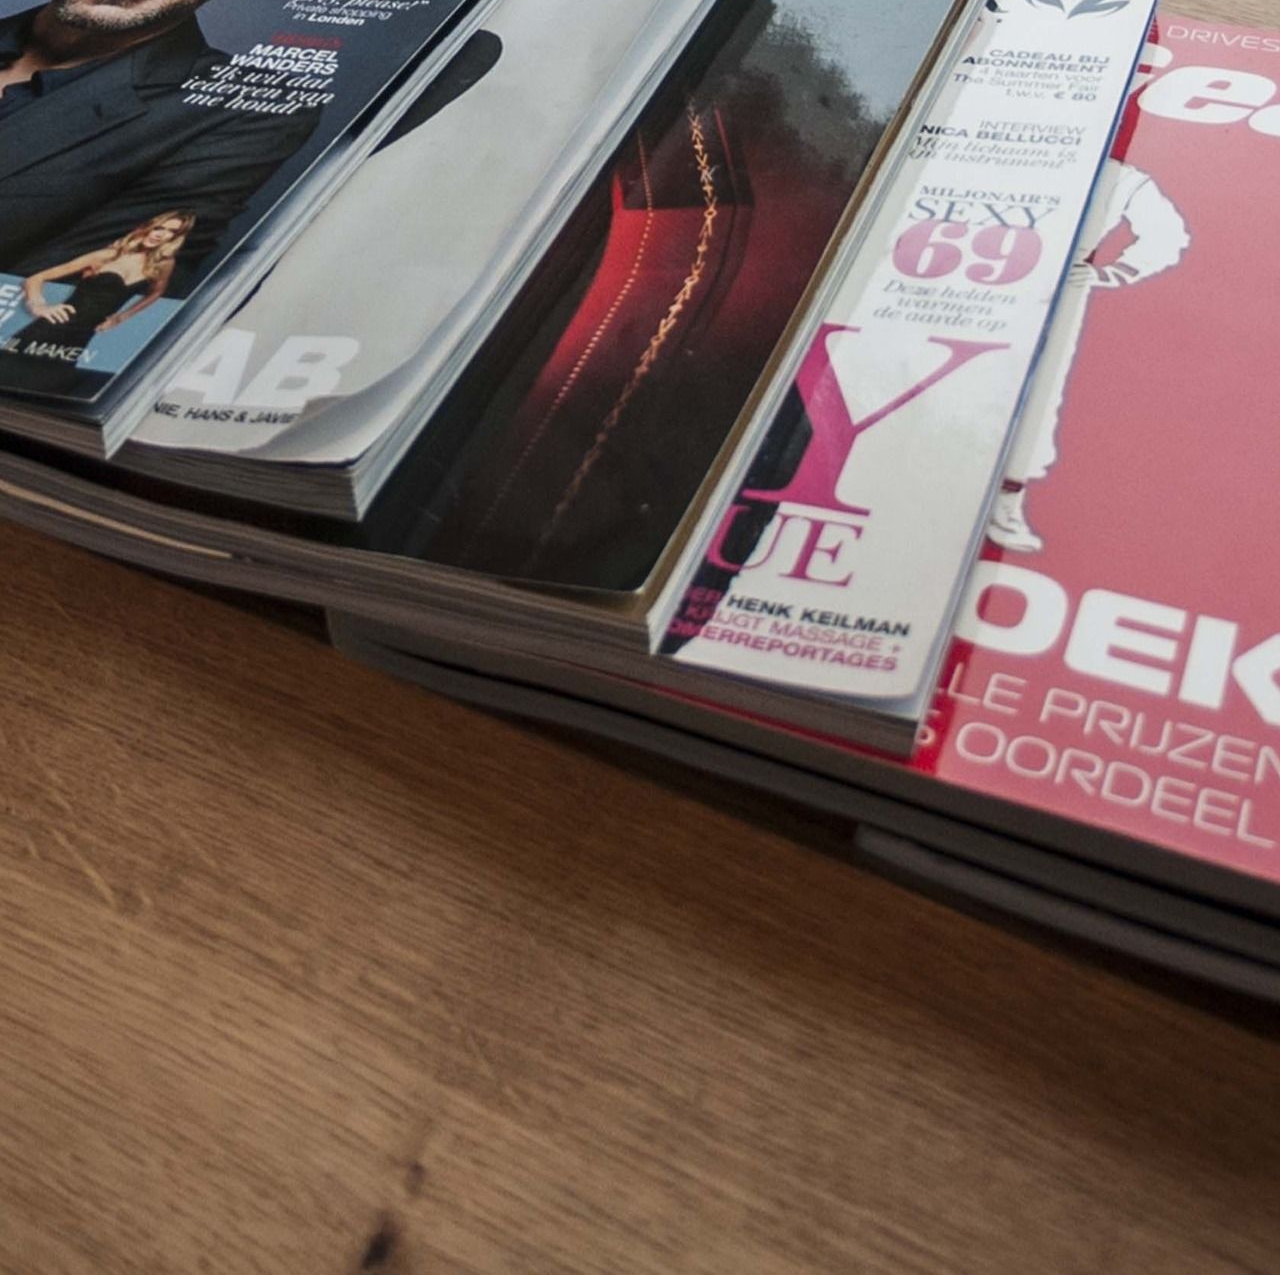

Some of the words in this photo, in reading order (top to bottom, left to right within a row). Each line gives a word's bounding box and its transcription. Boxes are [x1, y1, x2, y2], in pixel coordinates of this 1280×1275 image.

[307, 14, 365, 26] Londen
[329, 7, 393, 21] shopping
[249, 43, 339, 63] MARCEL
[988, 49, 1072, 62] CADEAU
[1078, 55, 1110, 64] BIJ
[230, 54, 340, 76] WANDERS
[961, 56, 1108, 74] ABONNEMENT
[181, 76, 282, 101] iedereen
[285, 90, 335, 105] van
[243, 70, 282, 86] wil
[285, 73, 333, 90] dat
[988, 77, 1063, 91] Summer
[1067, 82, 1102, 93] Fair
[183, 93, 225, 108] me
[920, 124, 969, 138] NICA
[975, 131, 1082, 146] BELLUCCI
[979, 119, 1086, 134] INTERVIEW
[920, 185, 1061, 206] MILJONAIR'S
[908, 197, 1056, 229] SEXY
[892, 218, 1043, 286] 69
[882, 279, 936, 296] Deze
[939, 285, 1017, 305] helden
[873, 305, 903, 320] de
[904, 309, 971, 328] aarde
[976, 318, 1008, 333] op
[22, 340, 99, 364] MAKEN
[184, 408, 231, 422] HANS
[234, 411, 248, 422] &
[741, 321, 1011, 516] Y
[705, 504, 864, 588] UE
[726, 593, 794, 619] HENK
[799, 607, 911, 637] KEILMAN
[769, 622, 885, 651] MASSAGE
[955, 721, 1277, 850] OORDEEL
